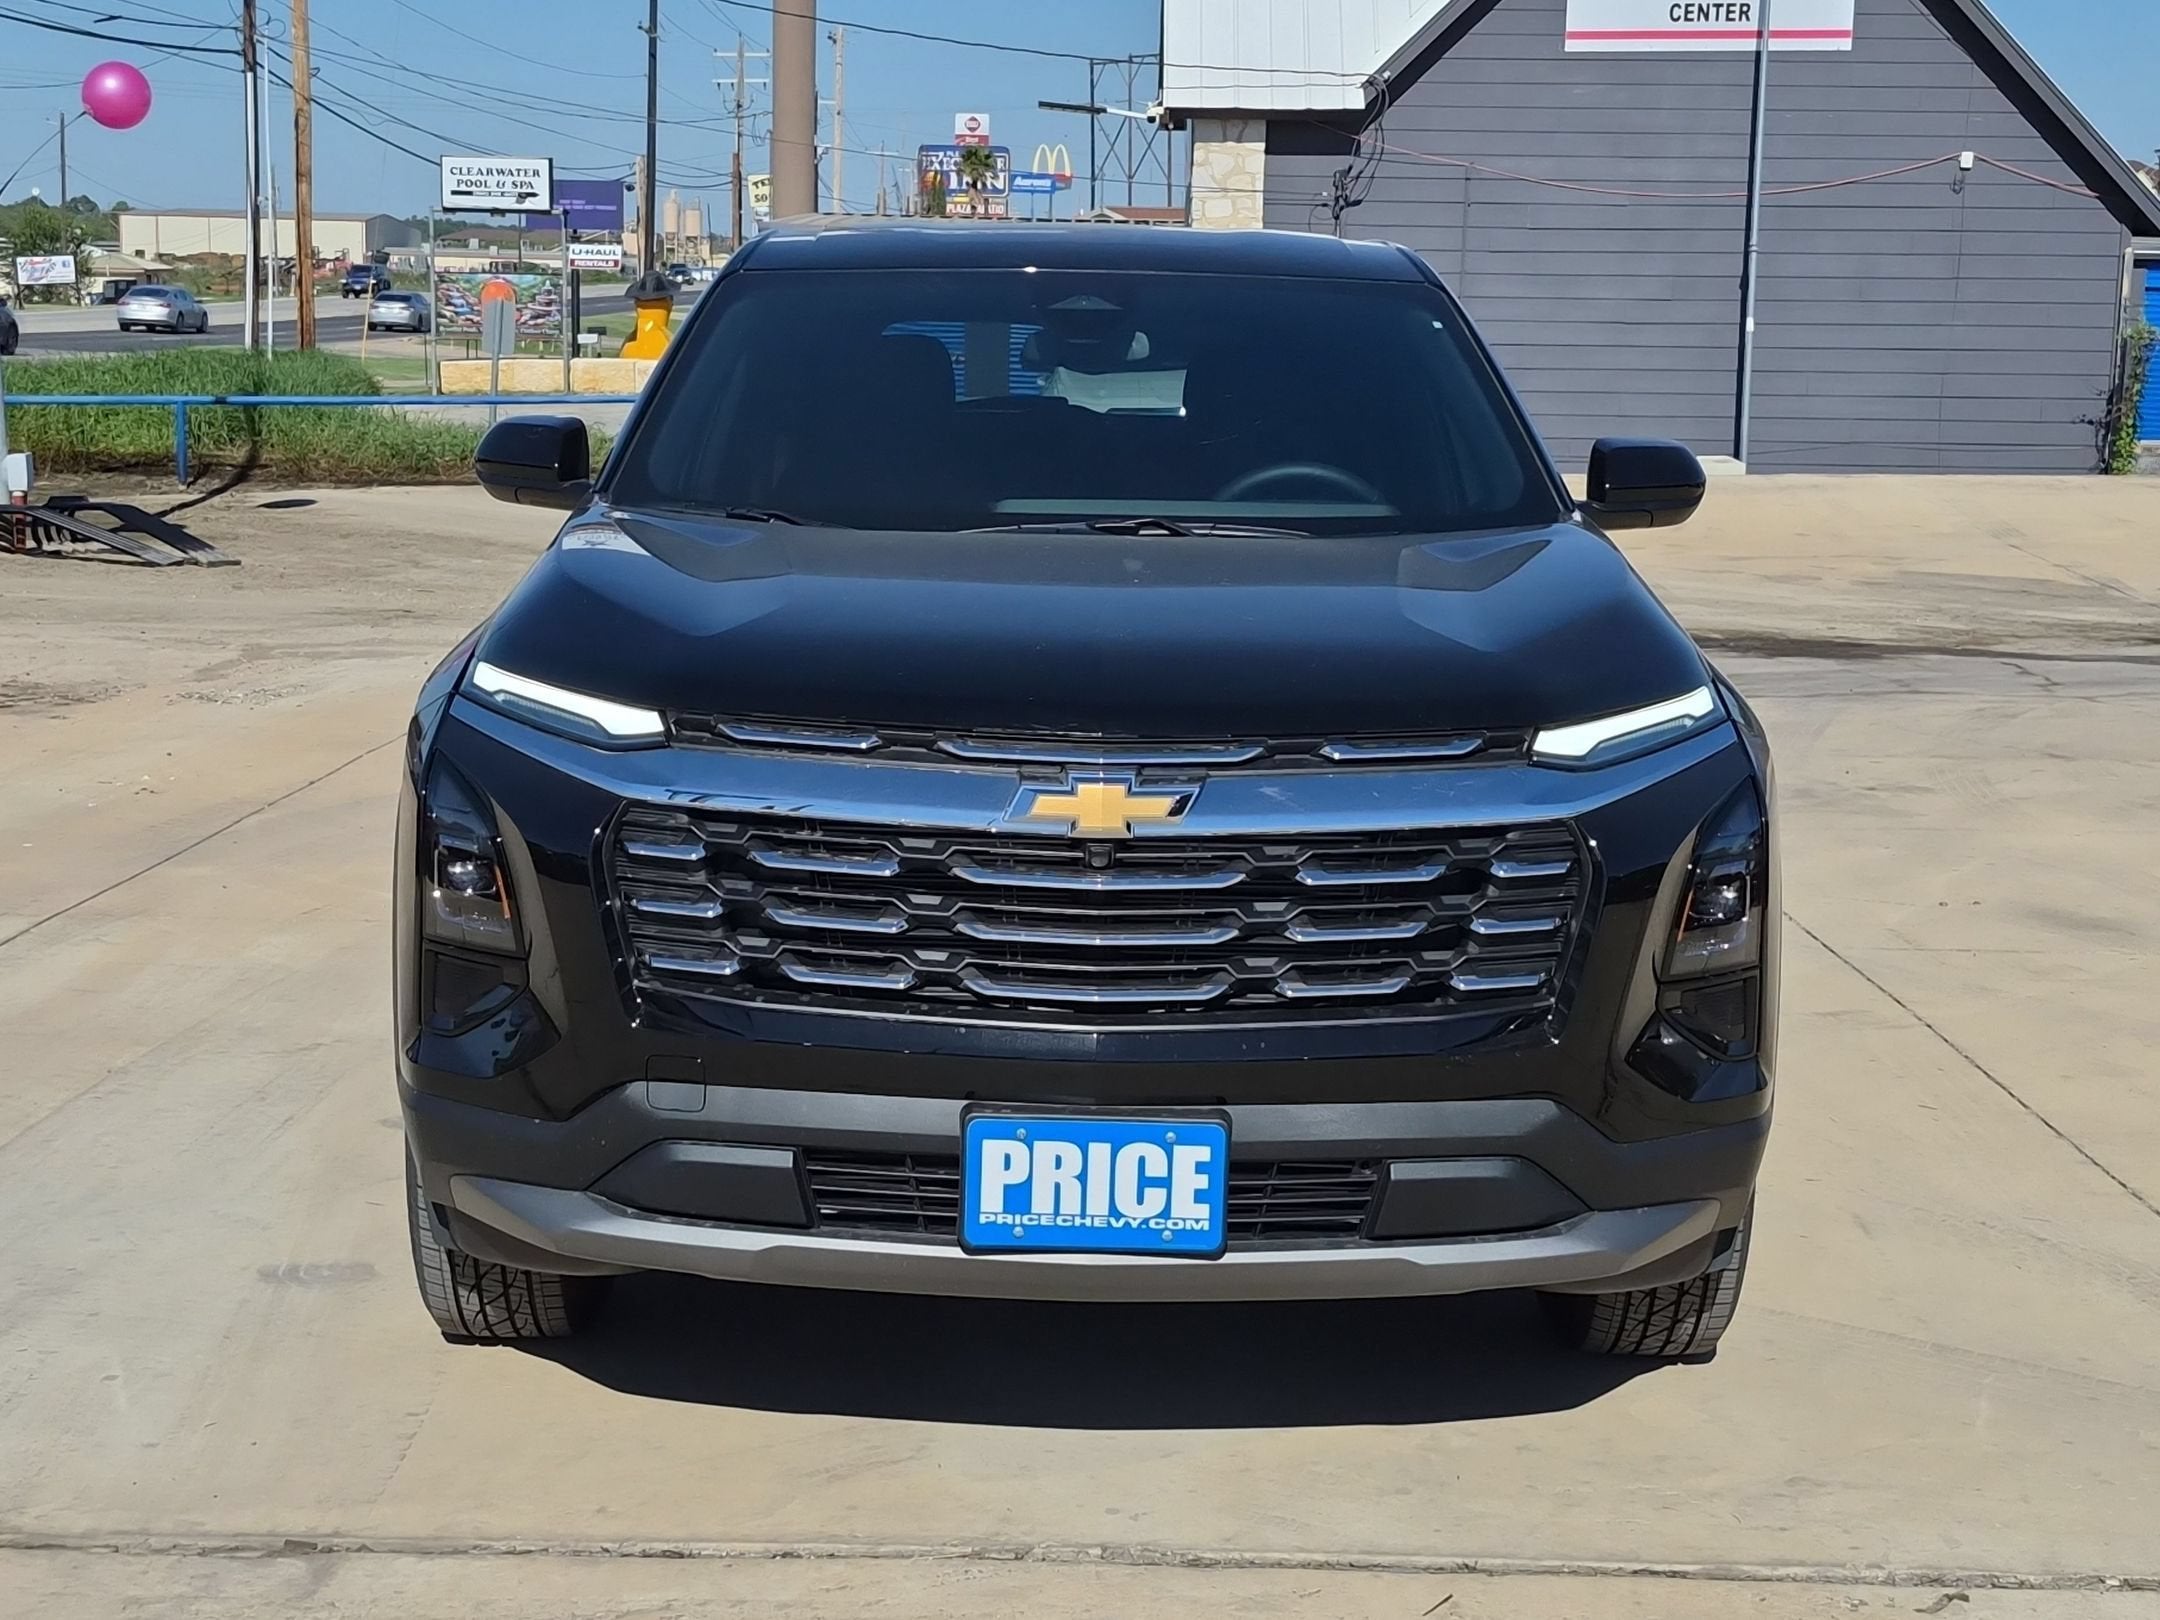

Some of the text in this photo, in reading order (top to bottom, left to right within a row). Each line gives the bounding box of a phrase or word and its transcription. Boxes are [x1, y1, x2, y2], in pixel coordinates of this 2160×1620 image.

[1669, 2, 1752, 22] CENTER
[450, 166, 541, 178] CLEARWATER
[456, 178, 535, 190] POOL & SPA
[571, 248, 619, 256] U-HAUL
[980, 1138, 1212, 1219] PRICE
[979, 1212, 1210, 1231] PRICECHEVY.COM
